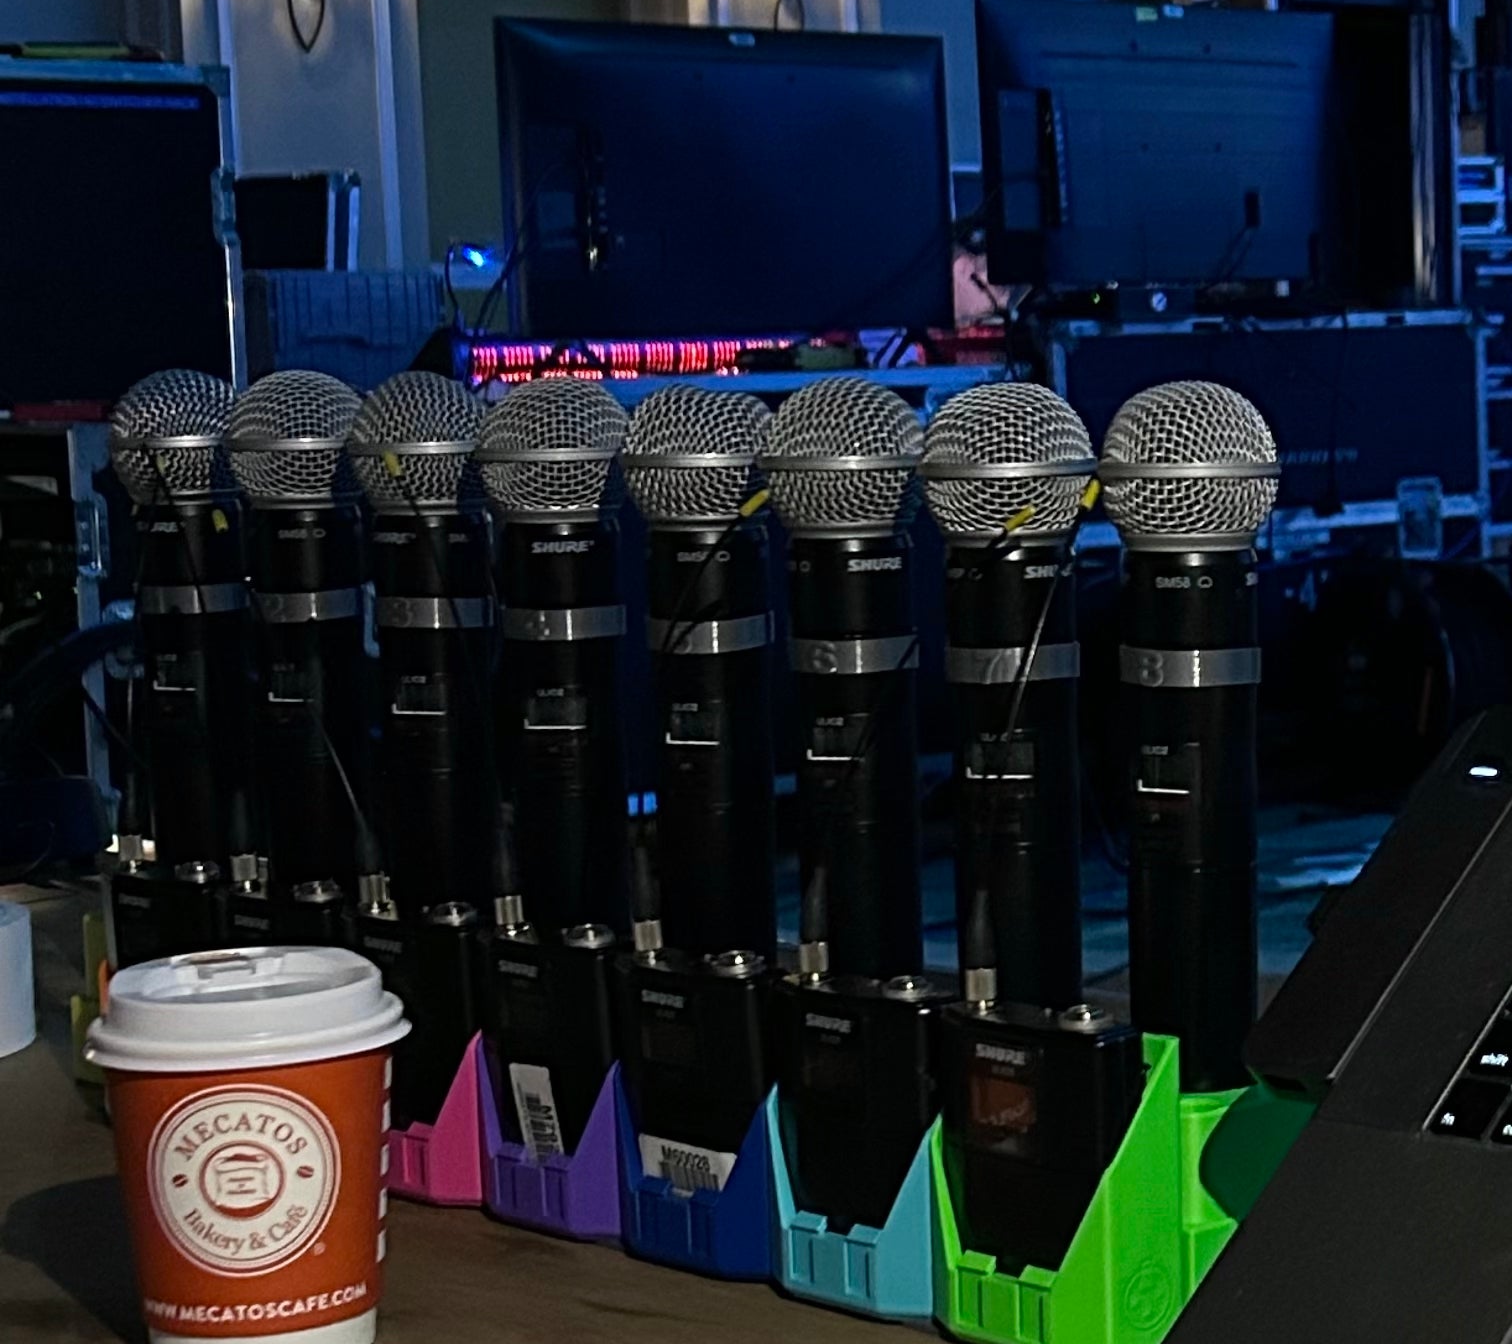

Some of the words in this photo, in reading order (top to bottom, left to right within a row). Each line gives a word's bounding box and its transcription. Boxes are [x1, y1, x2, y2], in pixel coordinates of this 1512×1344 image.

[531, 541, 590, 554] SHURE
[847, 557, 902, 572] SHURE
[1155, 576, 1191, 588] SM58
[975, 1042, 1026, 1065] SHURE
[173, 1111, 308, 1162] MECATOS
[183, 1207, 246, 1256] Bakery
[249, 1232, 267, 1251] &
